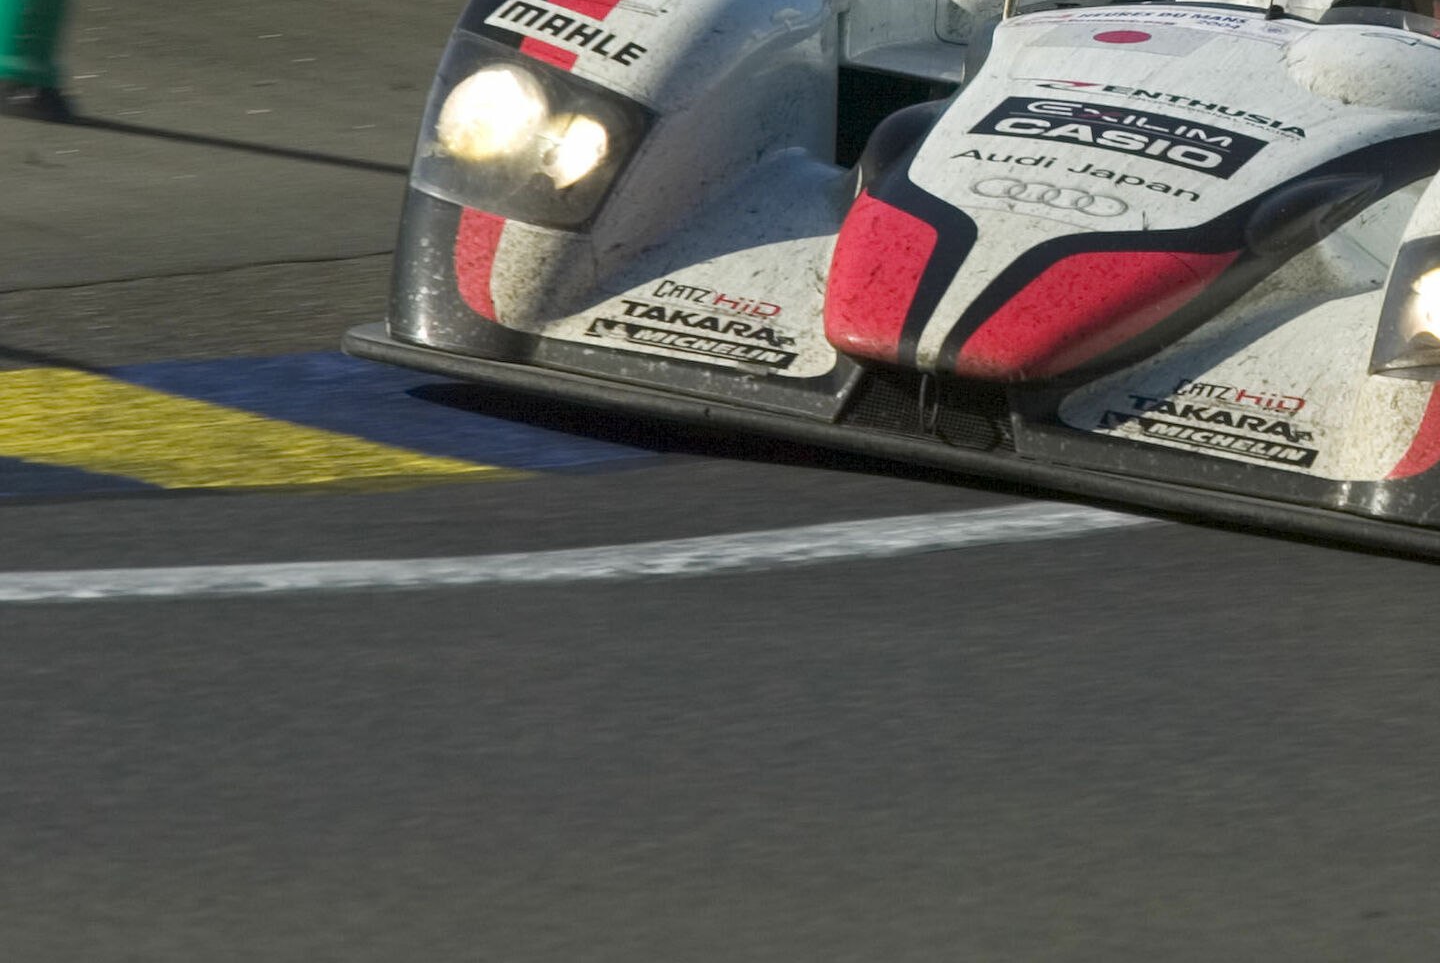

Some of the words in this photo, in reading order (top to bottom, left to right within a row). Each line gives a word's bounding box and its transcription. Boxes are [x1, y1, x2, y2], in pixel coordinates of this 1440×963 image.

[499, 1, 648, 66] MAHLE
[994, 117, 1223, 170] CASIO
[1027, 100, 1234, 148] EXILIM
[950, 149, 1058, 169] Audi
[1067, 164, 1201, 203] Japan
[621, 300, 776, 346] TAKARA
[633, 328, 787, 363] MICHELIN
[1129, 394, 1294, 440] TAKARA
[1149, 422, 1307, 463] MICHELIN
